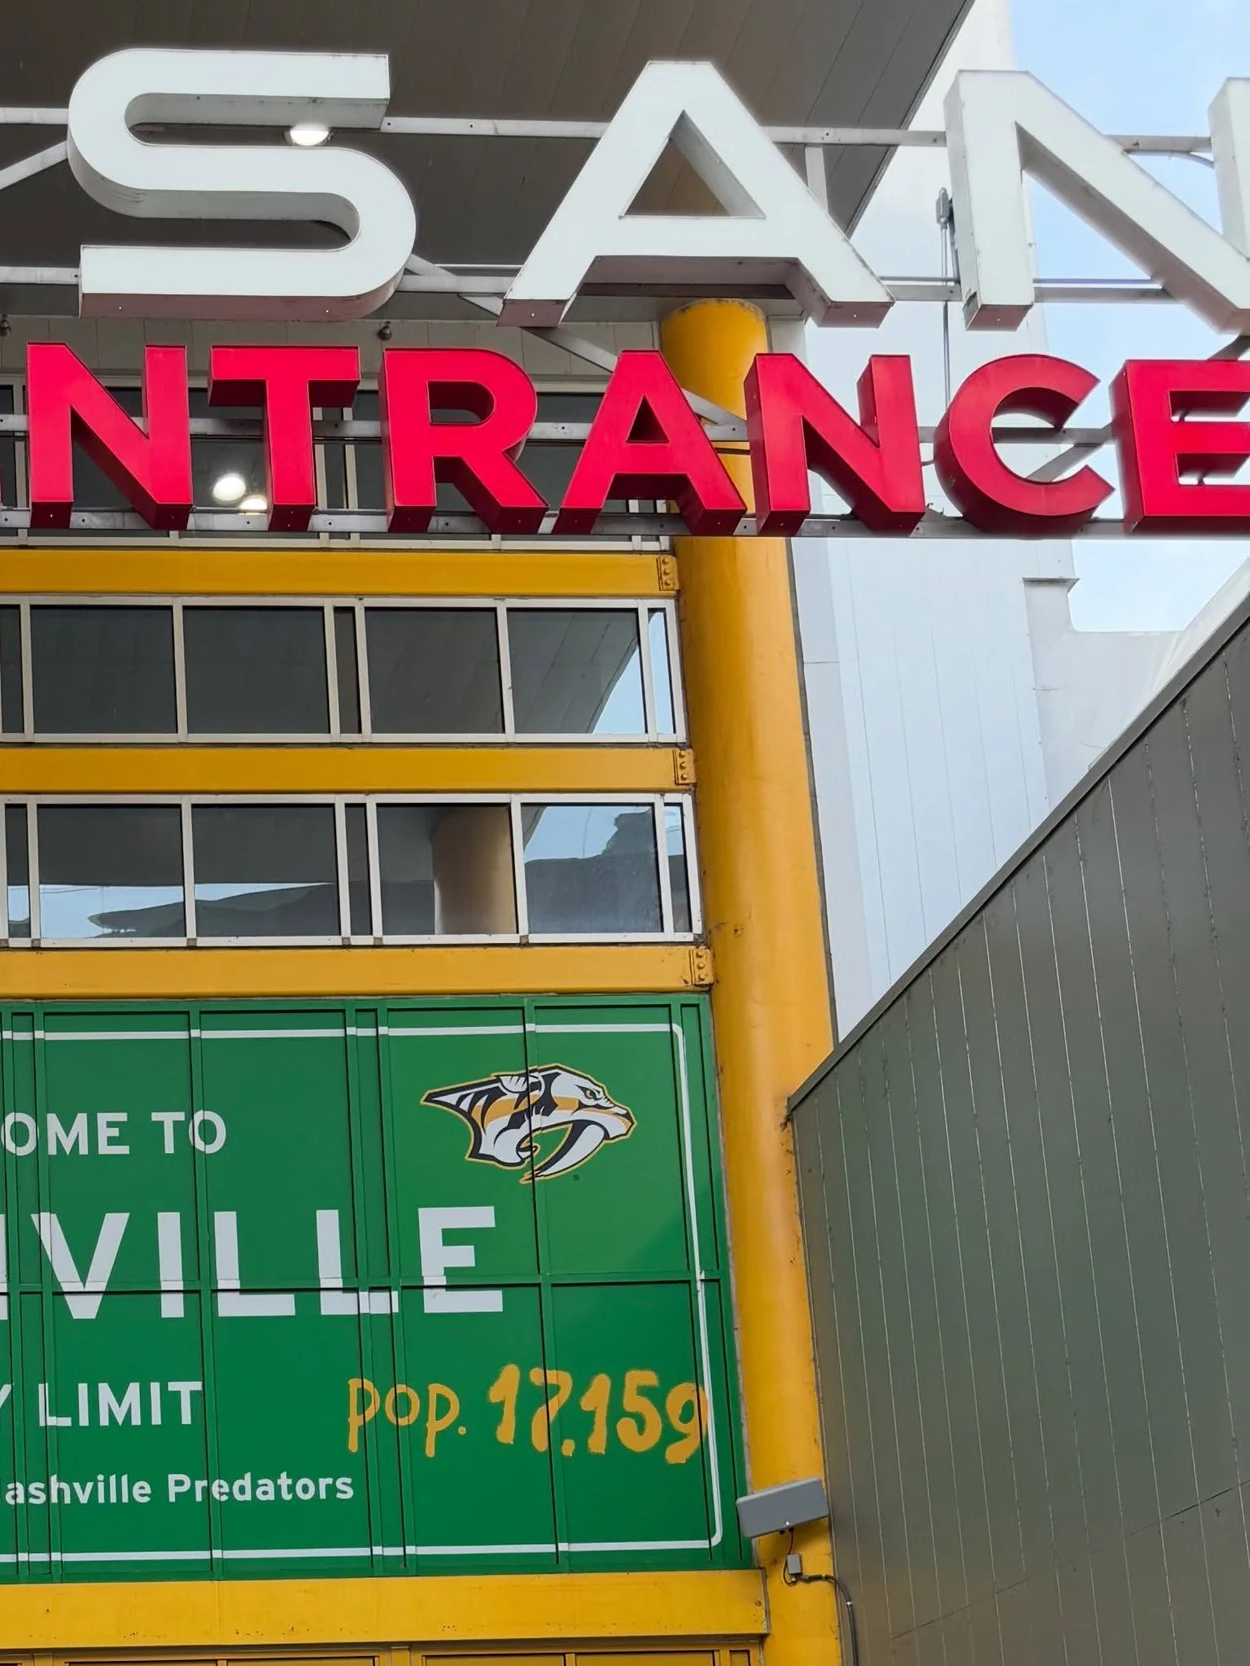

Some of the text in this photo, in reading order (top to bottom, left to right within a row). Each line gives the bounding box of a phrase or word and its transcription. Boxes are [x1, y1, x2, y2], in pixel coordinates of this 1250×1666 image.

[151, 1109, 227, 1155] TO
[37, 1380, 203, 1427] LIMIT
[347, 1377, 468, 1458] pop.
[168, 1471, 354, 1502] Predators
